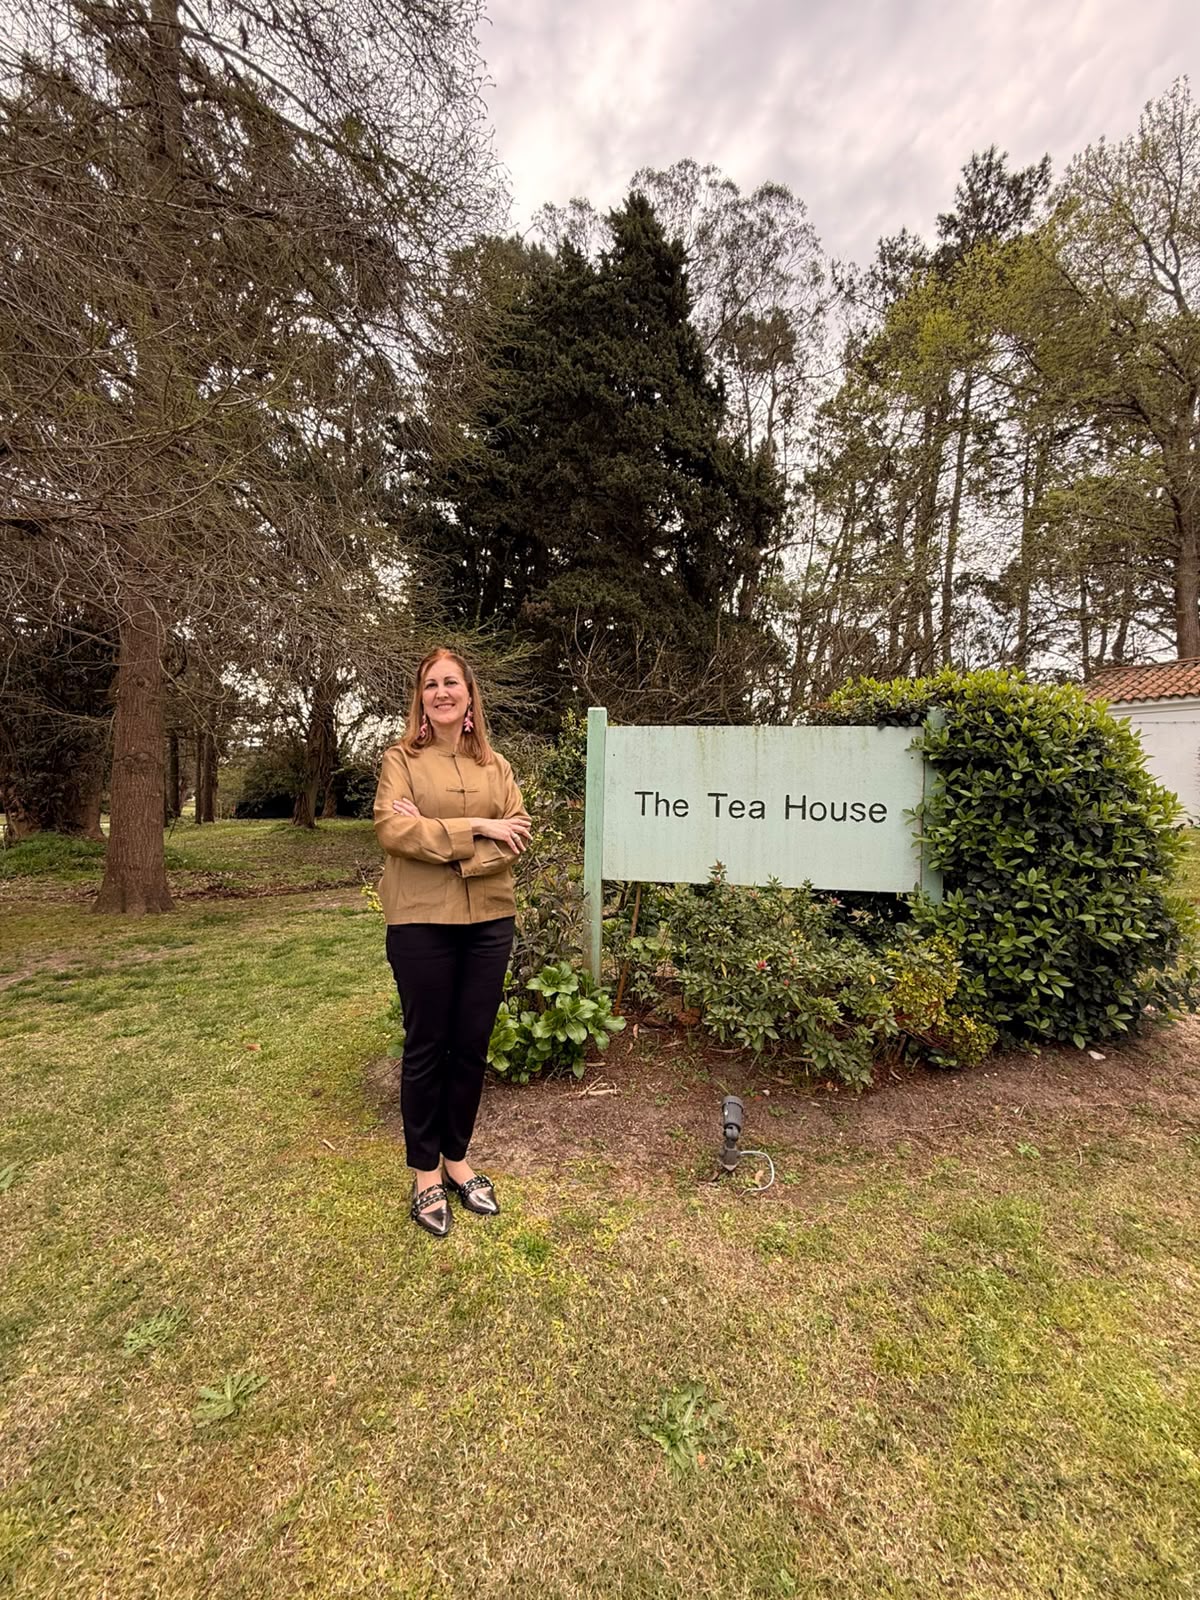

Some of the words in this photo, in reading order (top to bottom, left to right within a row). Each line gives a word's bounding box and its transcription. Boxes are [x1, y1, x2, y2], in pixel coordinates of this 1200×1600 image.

[634, 791, 689, 818] The
[707, 792, 766, 820] Tea
[785, 794, 888, 824] House
